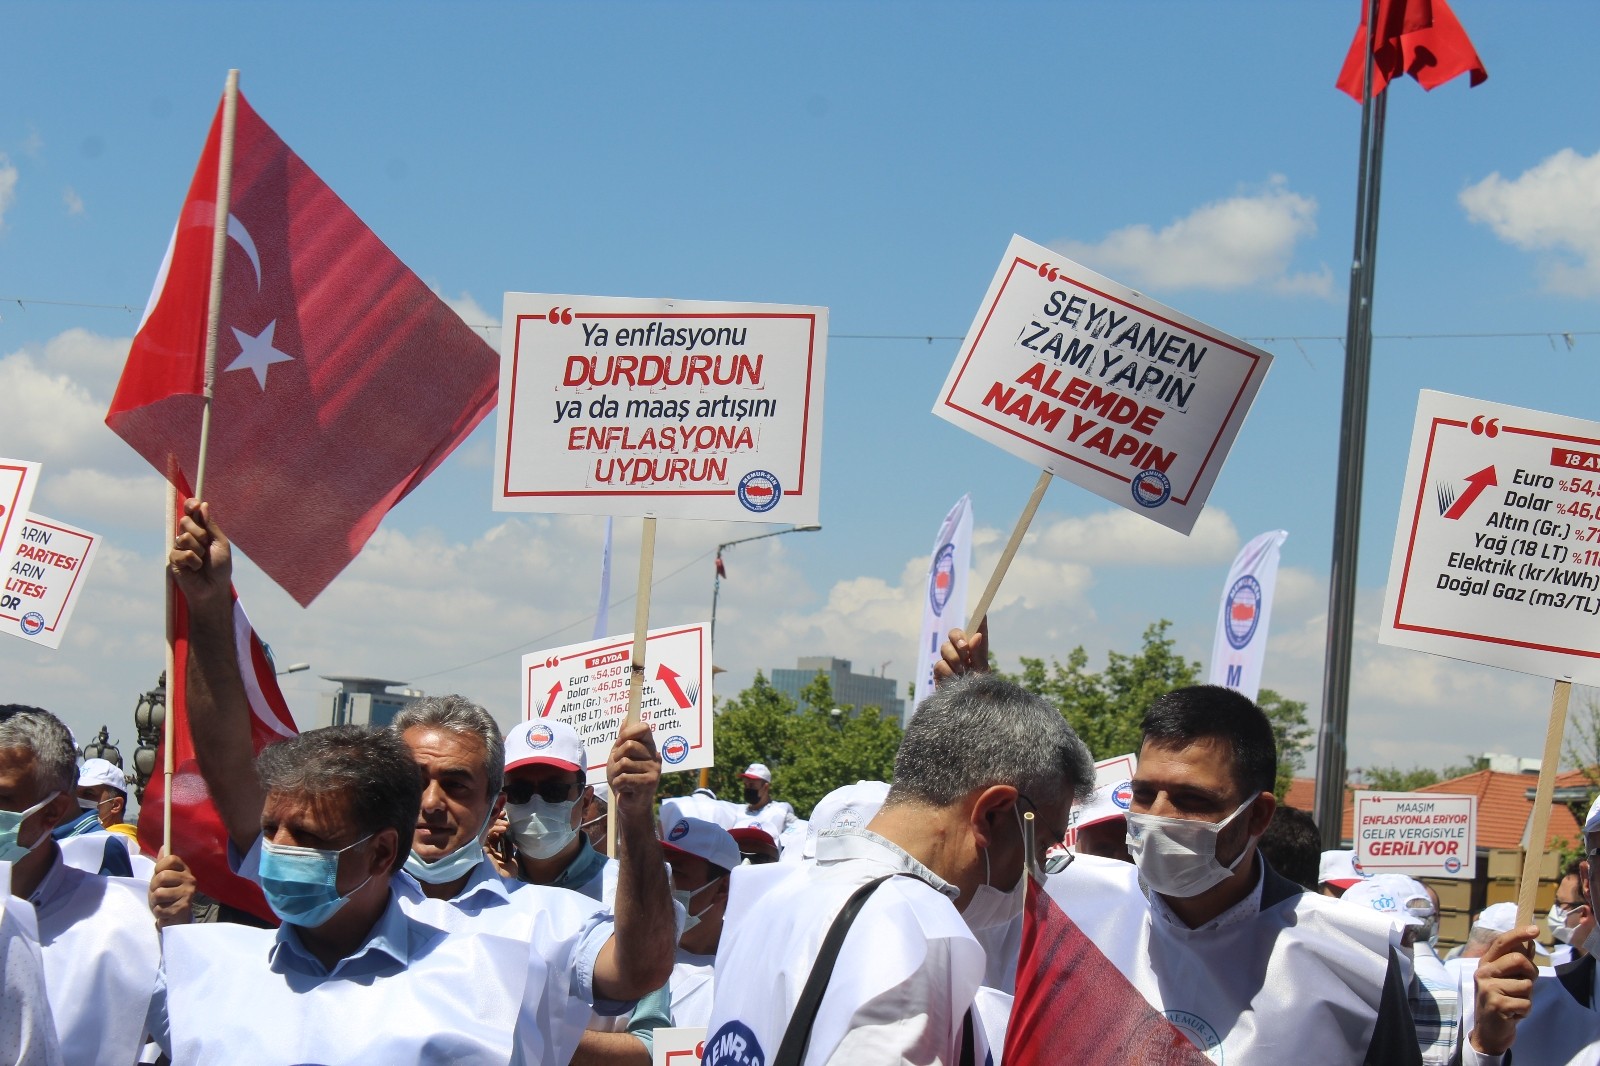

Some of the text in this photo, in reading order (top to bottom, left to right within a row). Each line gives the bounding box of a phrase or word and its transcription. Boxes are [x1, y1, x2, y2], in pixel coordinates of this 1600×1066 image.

[582, 322, 747, 350] Ya enflasyonu
[1043, 290, 1207, 373] SEYYANEN
[563, 354, 763, 387] DURDURUN
[1021, 321, 1195, 408] ZAM YAPIN
[553, 394, 776, 423] ya da maaş artışını
[1015, 361, 1165, 436] ALEMDE
[567, 425, 754, 451] ENFLASYONA
[981, 382, 1178, 473] NAM YAPIN
[595, 457, 728, 482] UYDURUN
[1565, 453, 1581, 466] 18
[1512, 468, 1554, 489] Euro
[1504, 490, 1553, 514] Dolar
[1486, 511, 1529, 532] Altın
[1533, 518, 1571, 541] (Gr.)
[1474, 532, 1508, 556] Yağ
[1511, 538, 1537, 557] (18
[1541, 543, 1569, 563] LT)
[1447, 552, 1600, 591] Elektrik (kr/kWh)
[1436, 573, 1489, 597] Doğal
[1493, 582, 1527, 602] Gaz
[601, 653, 622, 664] AYDA
[569, 675, 589, 686] Euro
[560, 702, 580, 713] Altın
[582, 696, 601, 708] (Gr.)
[567, 687, 590, 700] Dolar
[574, 711, 587, 724] (18
[589, 709, 602, 719] LT)
[587, 731, 618, 746] (m3/TL
[1362, 815, 1430, 825] ENFLASYONLA
[1396, 803, 1434, 814] MAAŞIM
